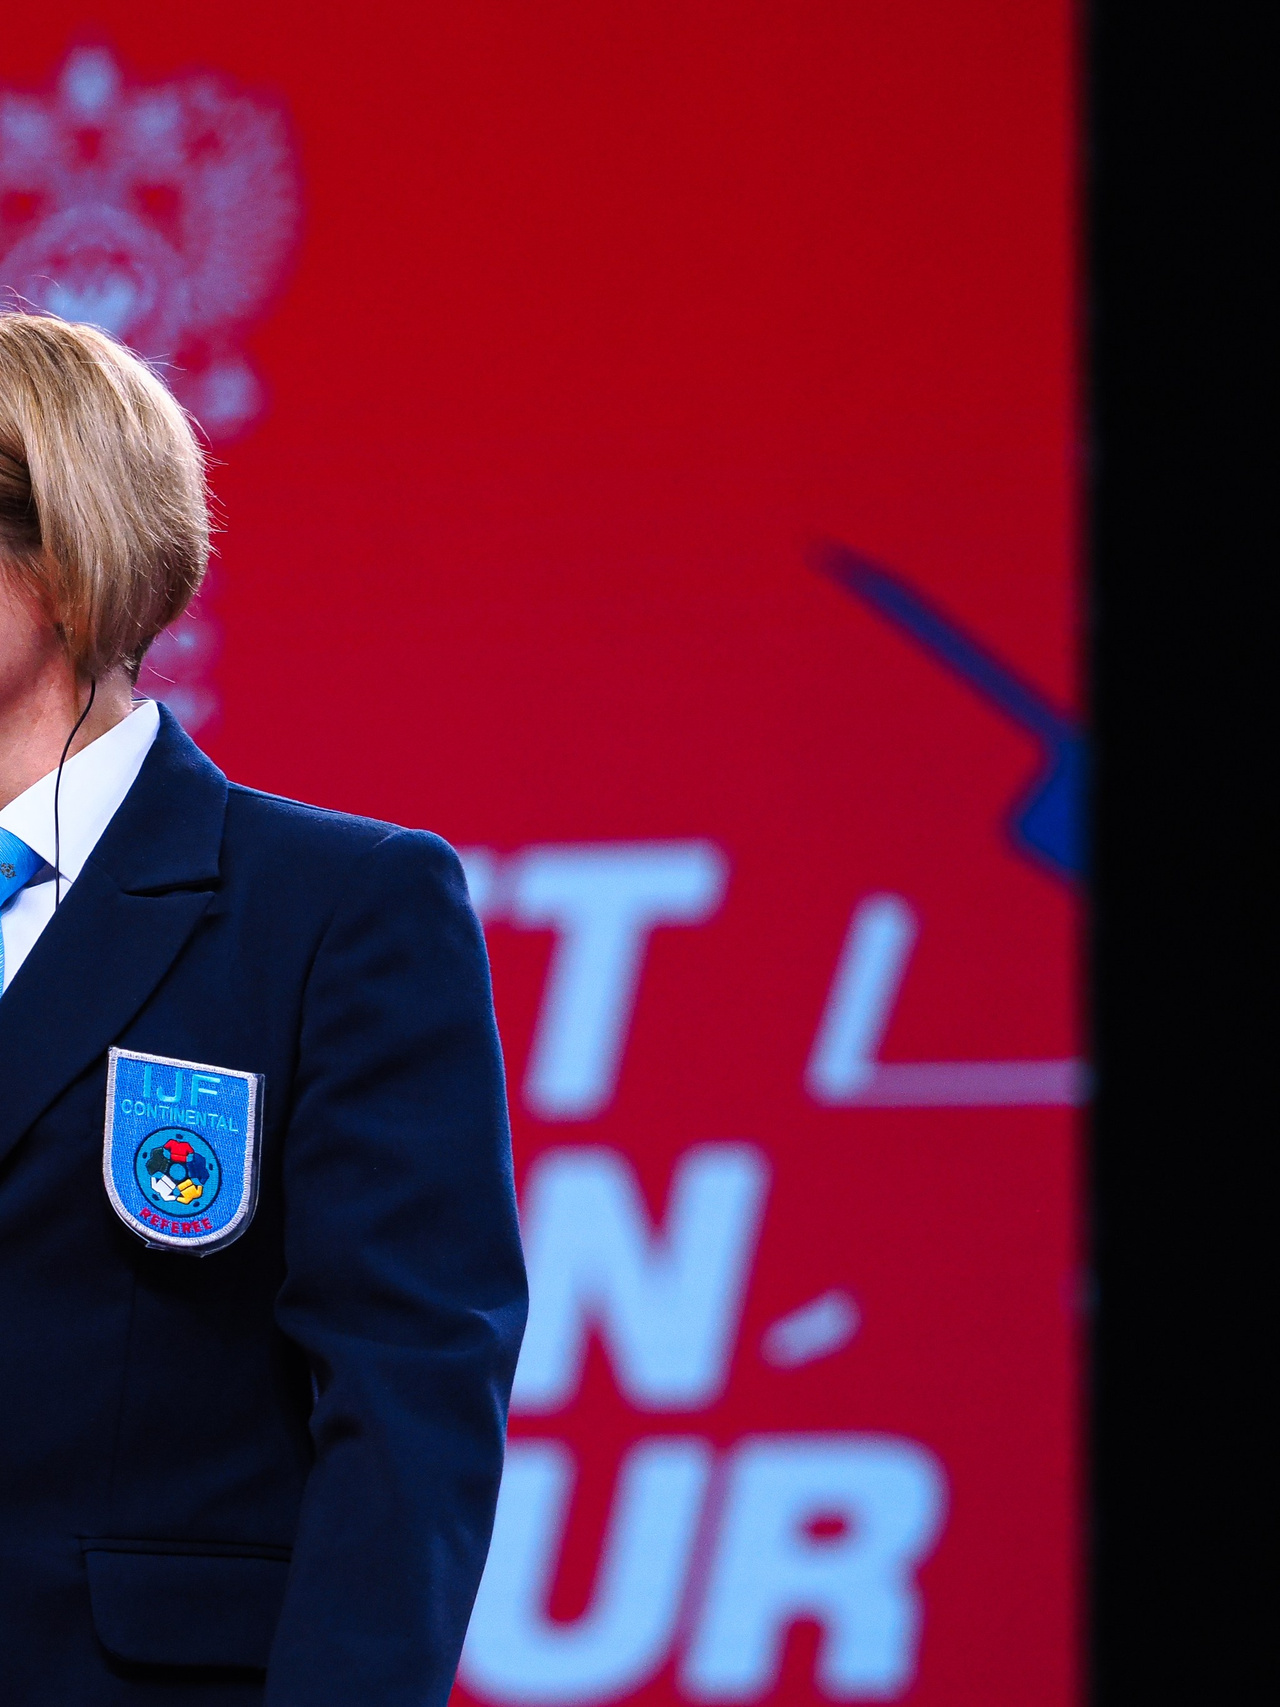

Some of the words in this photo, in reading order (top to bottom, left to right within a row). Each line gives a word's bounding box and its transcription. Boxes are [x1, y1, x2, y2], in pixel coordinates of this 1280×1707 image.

[142, 1065, 220, 1107] IJF
[121, 1098, 239, 1132] CONTINENTAL
[139, 1207, 212, 1234] REFEREE
